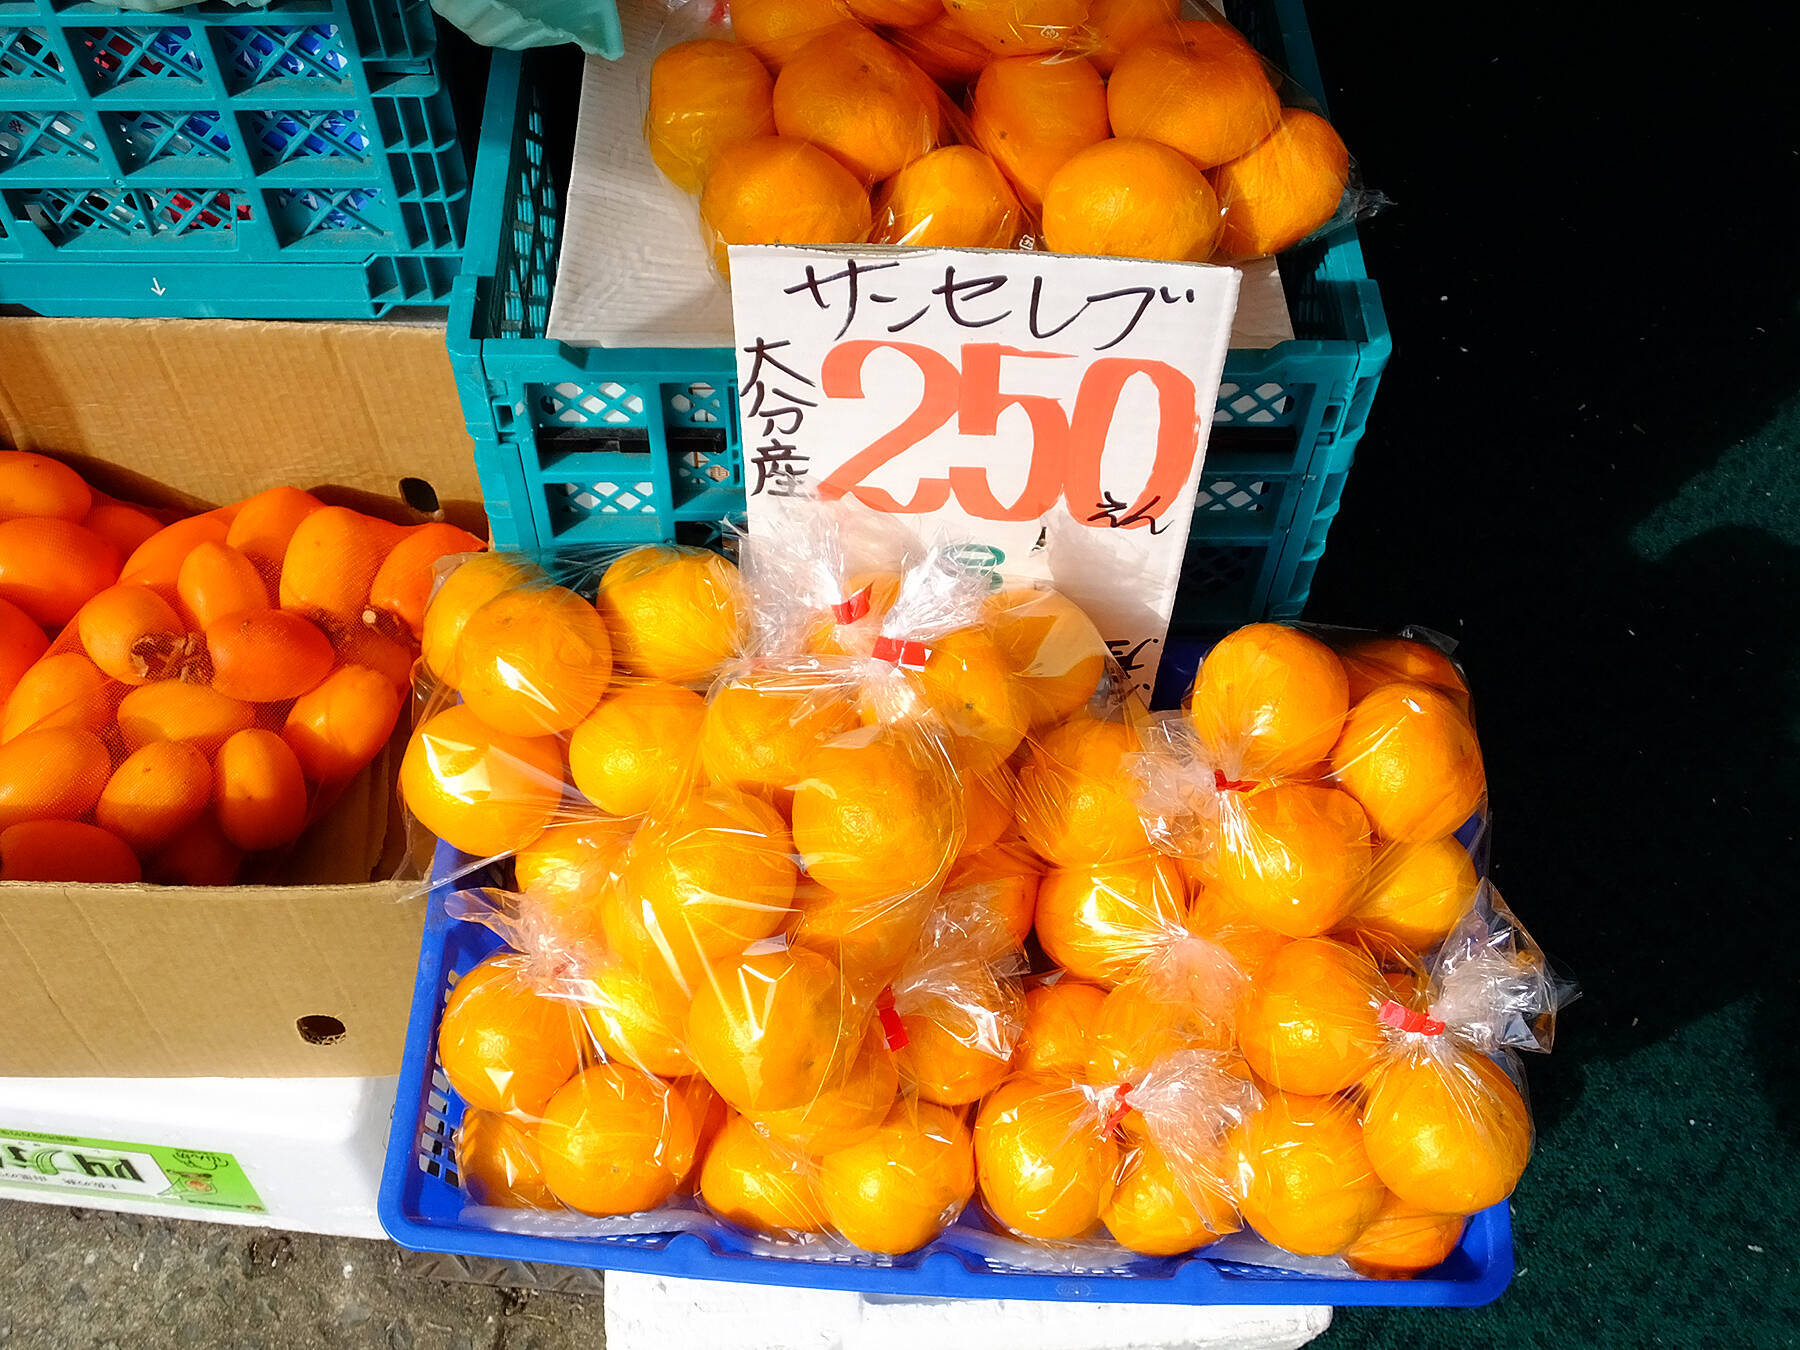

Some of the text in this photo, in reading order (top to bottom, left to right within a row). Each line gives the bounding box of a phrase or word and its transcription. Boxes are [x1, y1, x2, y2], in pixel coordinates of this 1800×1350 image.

[784, 259, 1195, 350] サンセレブ
[740, 336, 818, 498] 大分産
[817, 339, 1200, 535] 250 えん
